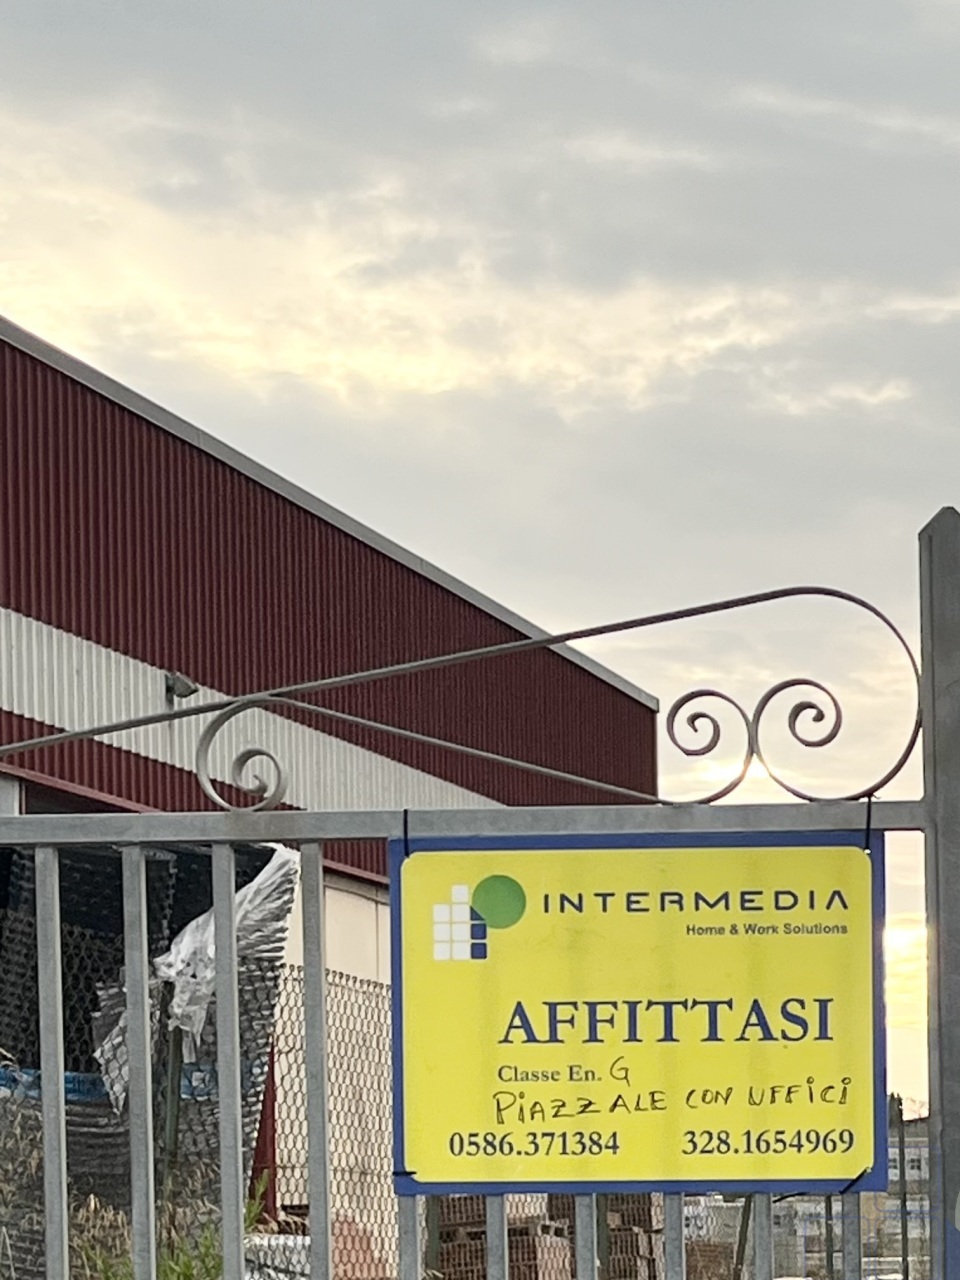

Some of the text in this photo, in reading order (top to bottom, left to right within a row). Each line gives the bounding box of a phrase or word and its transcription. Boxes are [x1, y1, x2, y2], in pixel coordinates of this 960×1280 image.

[543, 889, 849, 914] INTERMEDIA
[686, 922, 848, 936] Home & Work Solutions
[497, 997, 834, 1044] AFFITTASI
[497, 1055, 631, 1087] Classe En. G
[685, 1086, 734, 1109] CON
[449, 1130, 620, 1157] 0586.371384
[681, 1128, 854, 1155] 328.1654969
